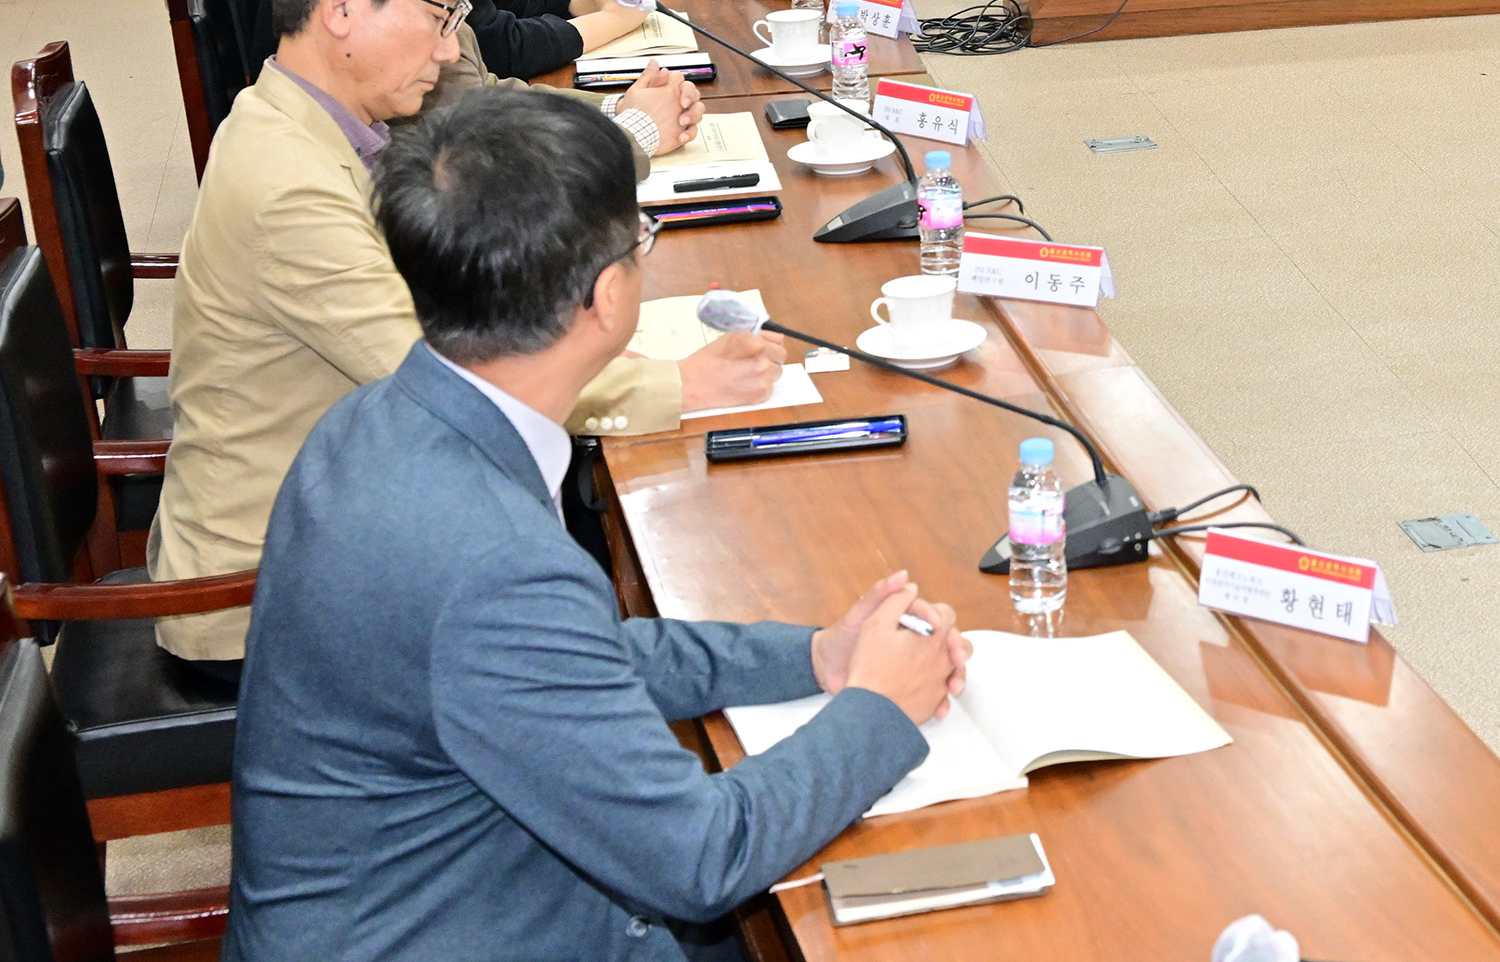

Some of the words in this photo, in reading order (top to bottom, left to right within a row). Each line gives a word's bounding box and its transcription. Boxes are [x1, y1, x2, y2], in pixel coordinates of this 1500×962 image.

[917, 112, 958, 135] 홍유식
[1025, 271, 1085, 294] 이동주
[1280, 588, 1353, 626] 황현태
